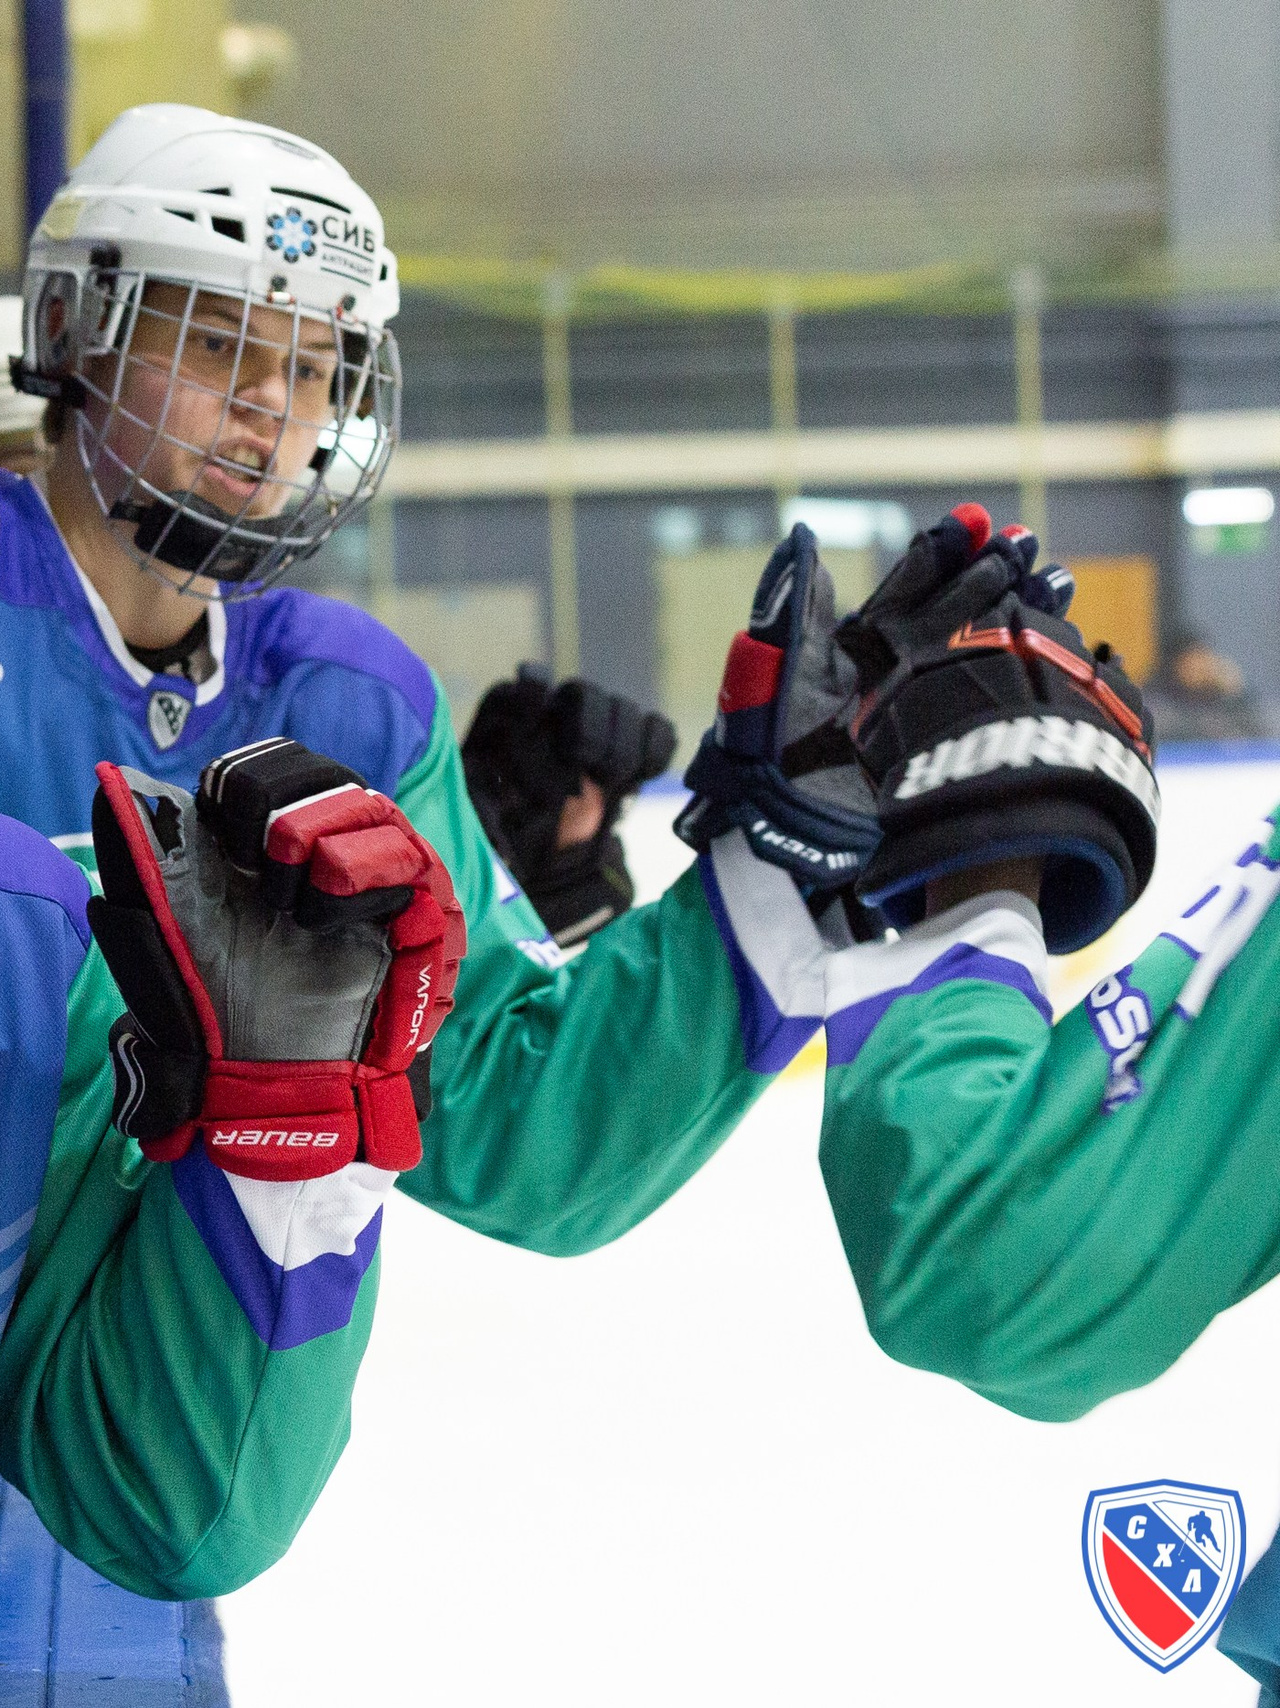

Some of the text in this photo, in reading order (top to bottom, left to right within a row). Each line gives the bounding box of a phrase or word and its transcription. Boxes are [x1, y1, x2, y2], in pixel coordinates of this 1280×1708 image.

[322, 215, 375, 253] СИБ
[402, 963, 432, 1053] VAPOR
[211, 1130, 340, 1148] BAUER
